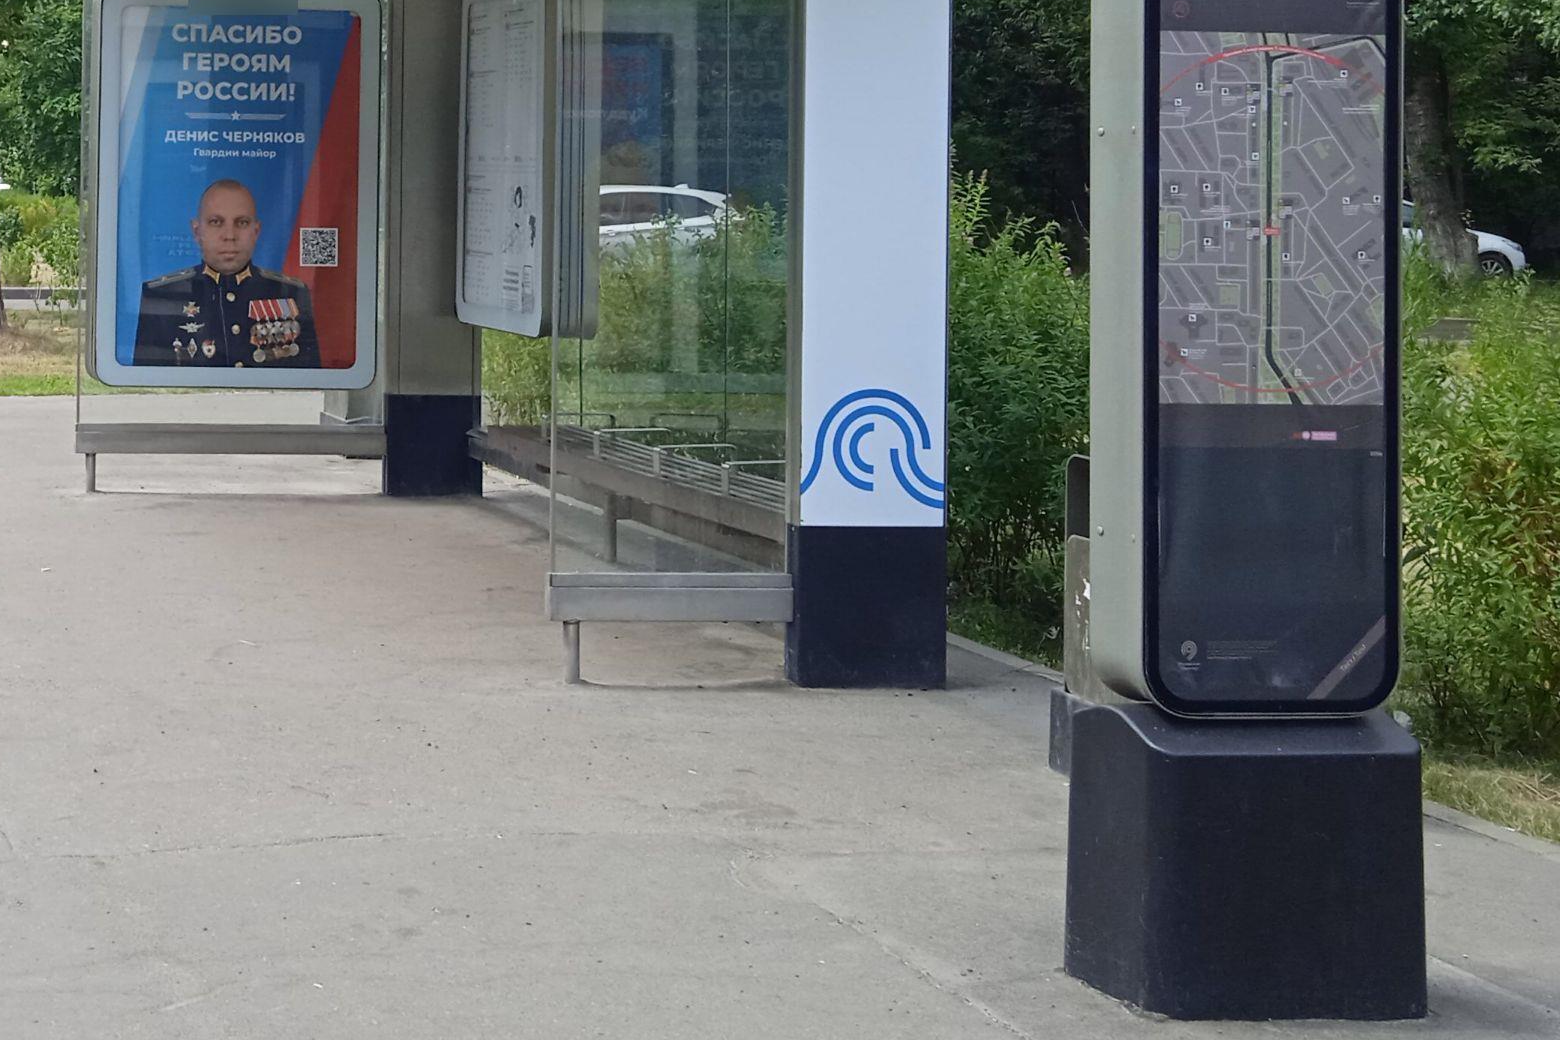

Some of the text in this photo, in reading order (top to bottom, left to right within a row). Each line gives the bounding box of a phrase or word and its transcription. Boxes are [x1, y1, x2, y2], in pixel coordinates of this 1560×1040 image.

[171, 22, 303, 45] СПАСИБО
[182, 52, 291, 73] ГЕРОЯМ
[176, 81, 296, 102] РОССИИ!
[164, 129, 306, 144] ДЕНИС ЧЕРНЯКОВ
[193, 147, 277, 161] Гвардии майор
